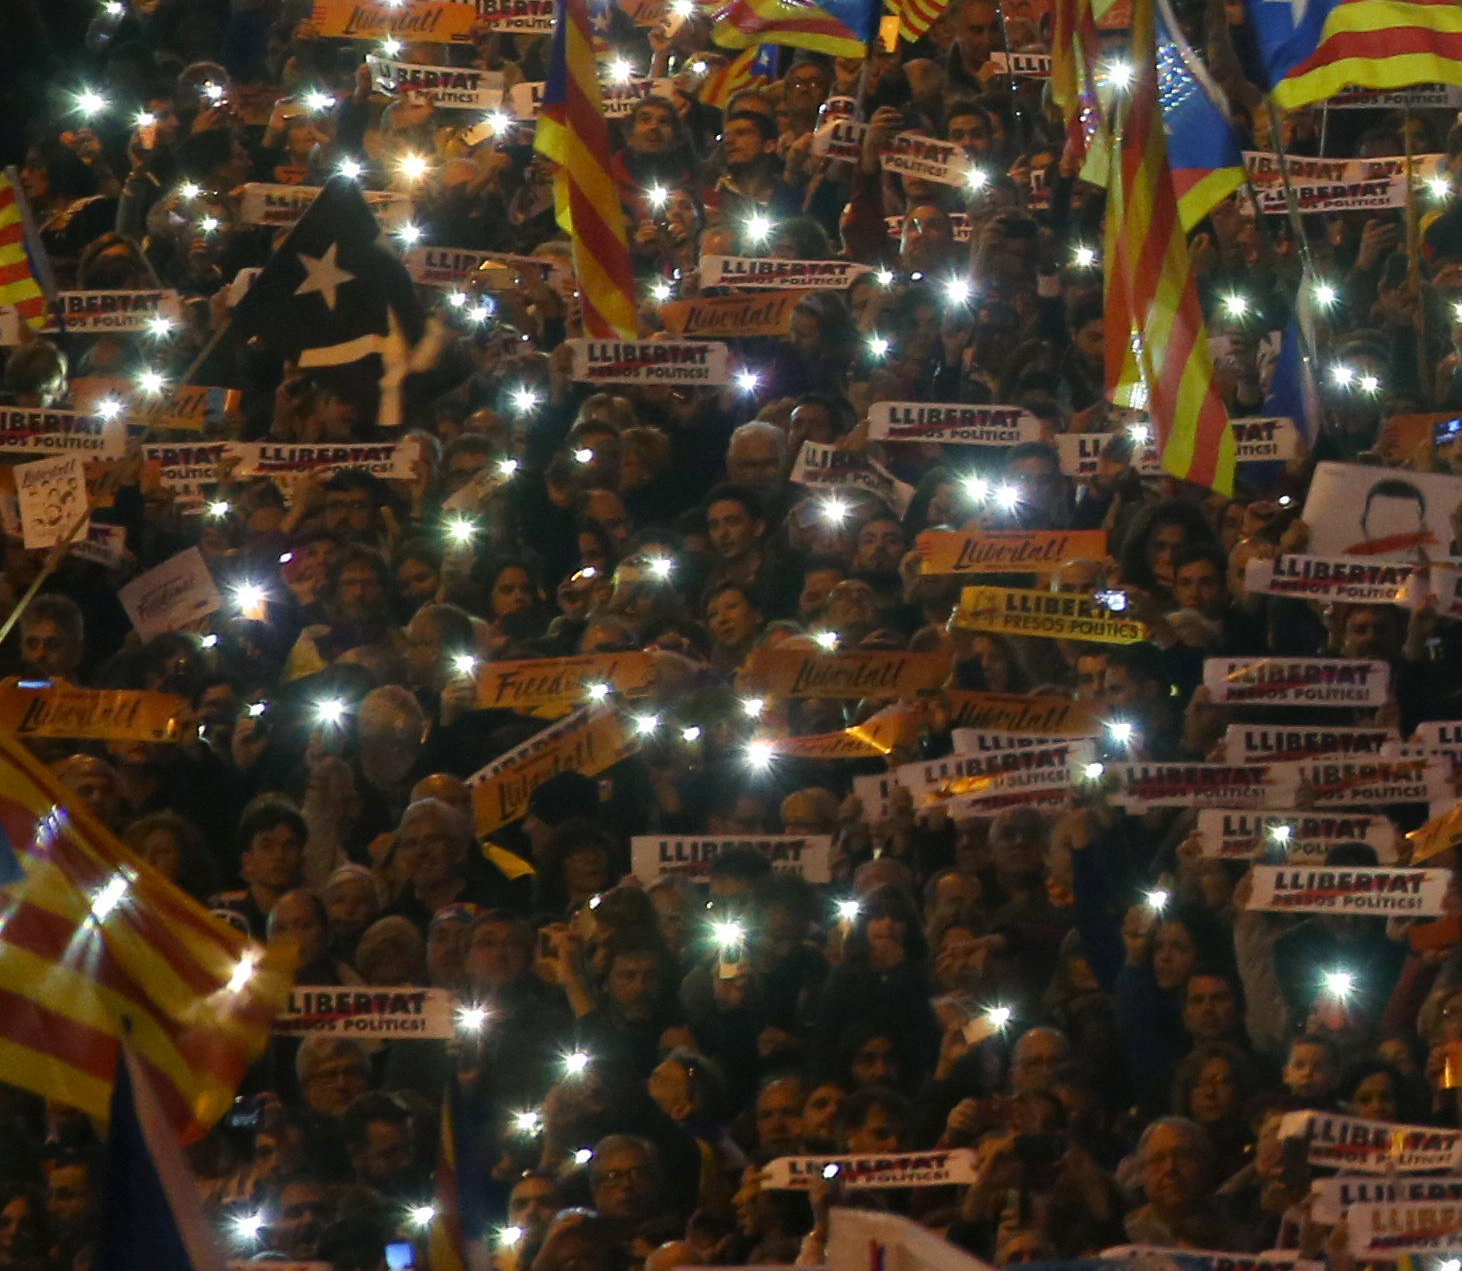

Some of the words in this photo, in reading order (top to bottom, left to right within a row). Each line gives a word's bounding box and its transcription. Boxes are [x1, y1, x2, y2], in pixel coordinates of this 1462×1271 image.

[588, 343, 708, 364] LLIBERTAT
[889, 408, 1026, 428] LLIBERTAT
[956, 538, 1068, 568] Llibertat!
[1272, 559, 1412, 586] LLIBERTAT
[1002, 615, 1066, 631] PRESOS
